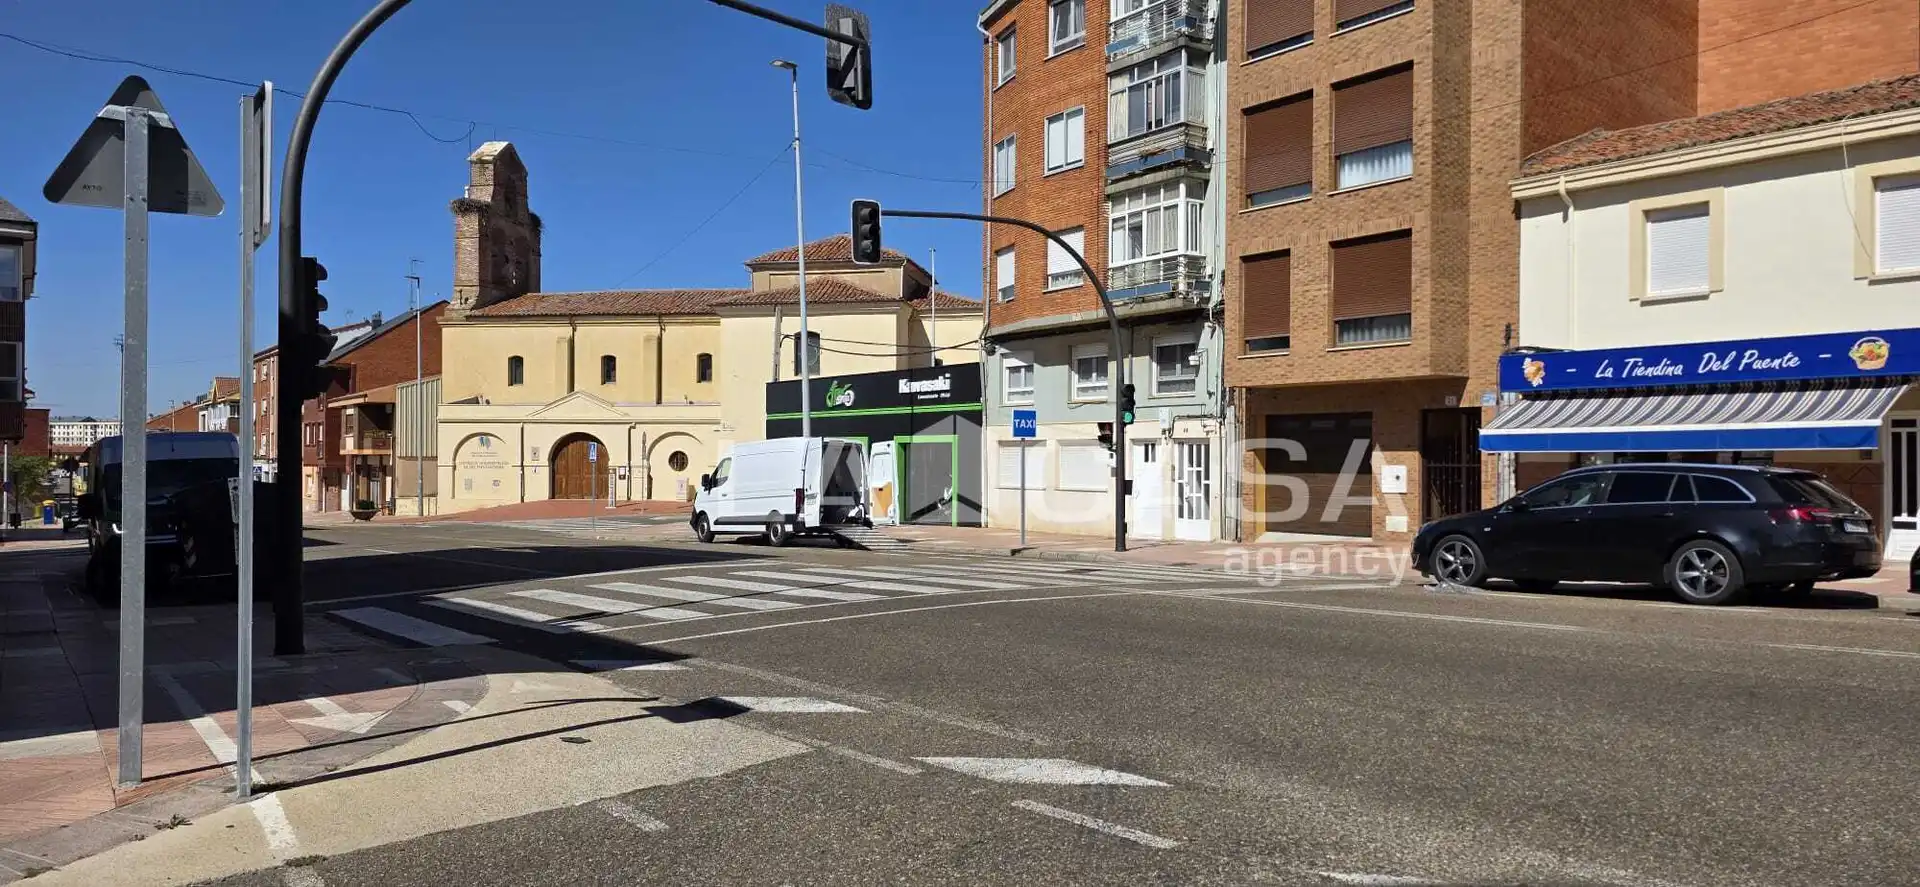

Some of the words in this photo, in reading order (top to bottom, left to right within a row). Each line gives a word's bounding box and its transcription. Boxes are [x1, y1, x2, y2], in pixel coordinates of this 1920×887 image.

[1594, 358, 1614, 379] La
[1621, 356, 1684, 379] Tiendina
[1696, 350, 1737, 374] Del
[1738, 349, 1802, 372] Puente
[898, 373, 951, 393] Kawasaki
[1013, 419, 1036, 429] TAXI
